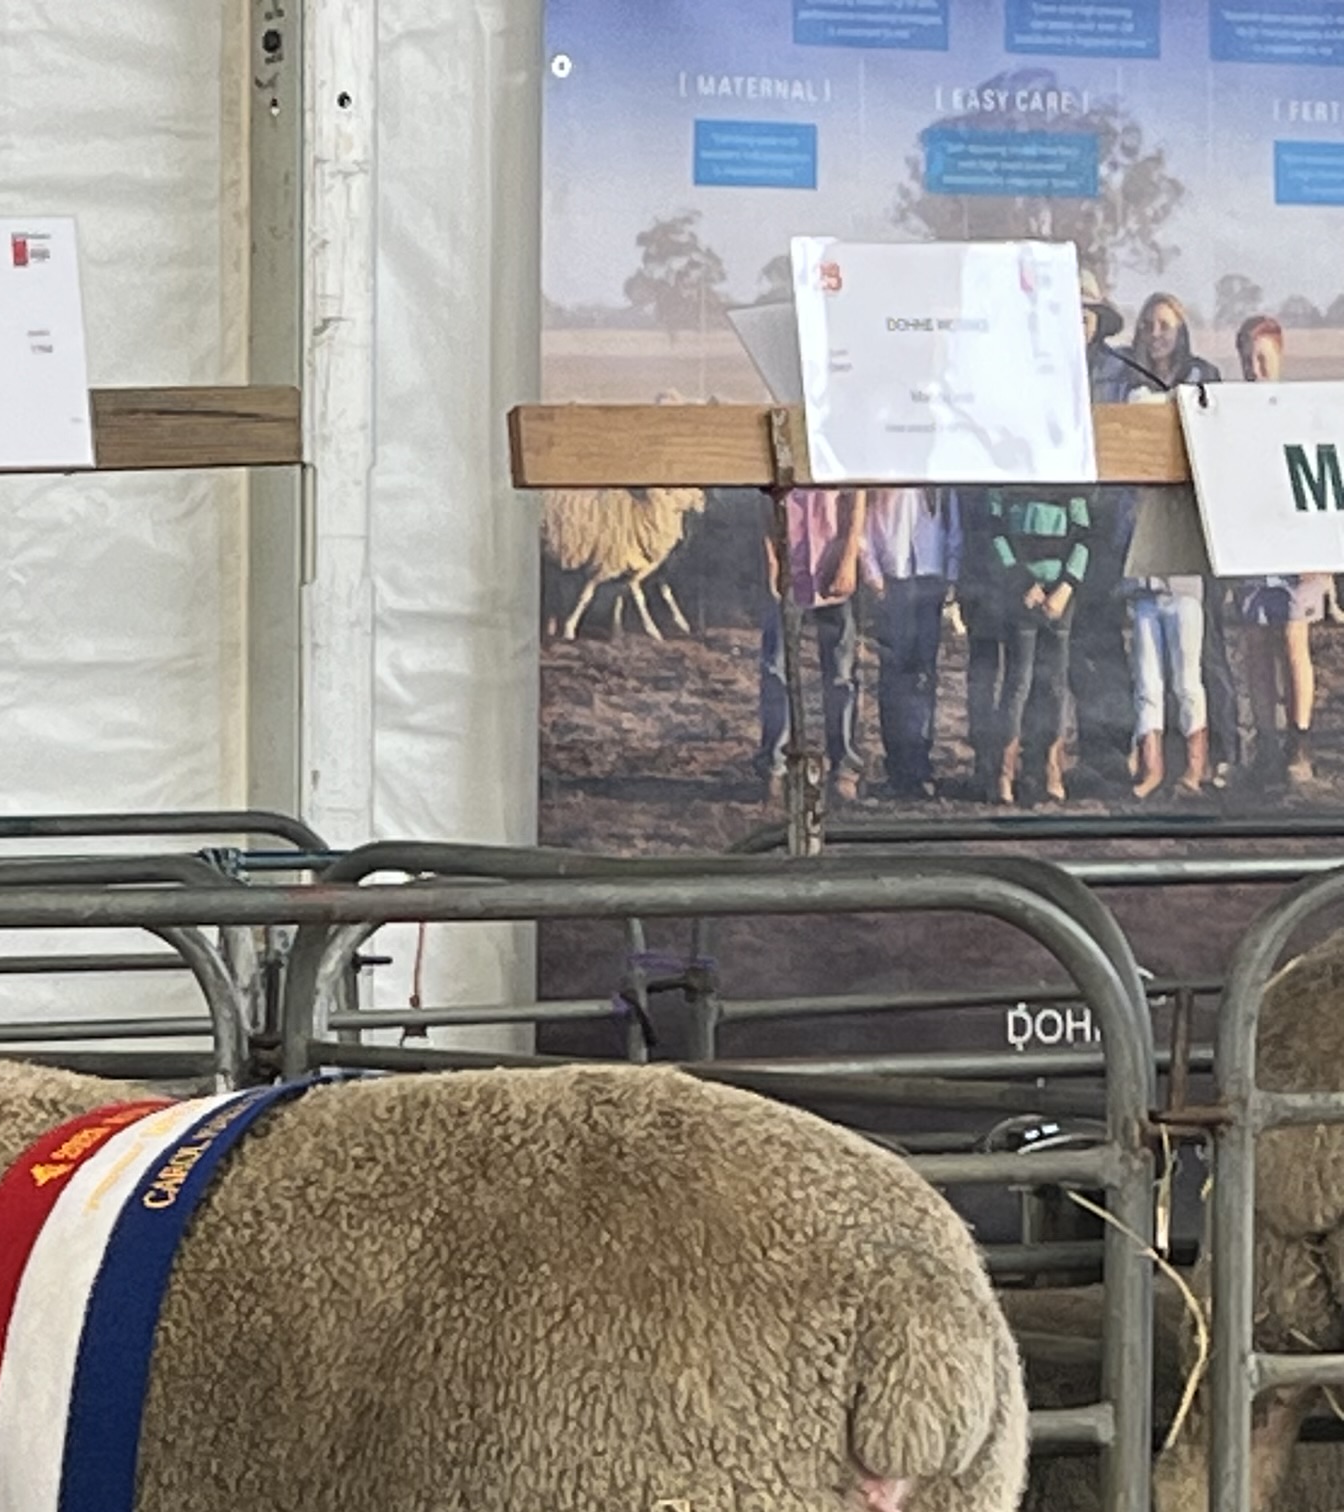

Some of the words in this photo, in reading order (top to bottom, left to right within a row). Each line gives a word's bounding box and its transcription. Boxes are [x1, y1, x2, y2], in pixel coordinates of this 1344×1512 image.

[697, 74, 817, 101] MATERNAL
[952, 88, 1010, 112] EASY
[1015, 90, 1073, 113] CARE
[1007, 1008, 1101, 1044] DOH
